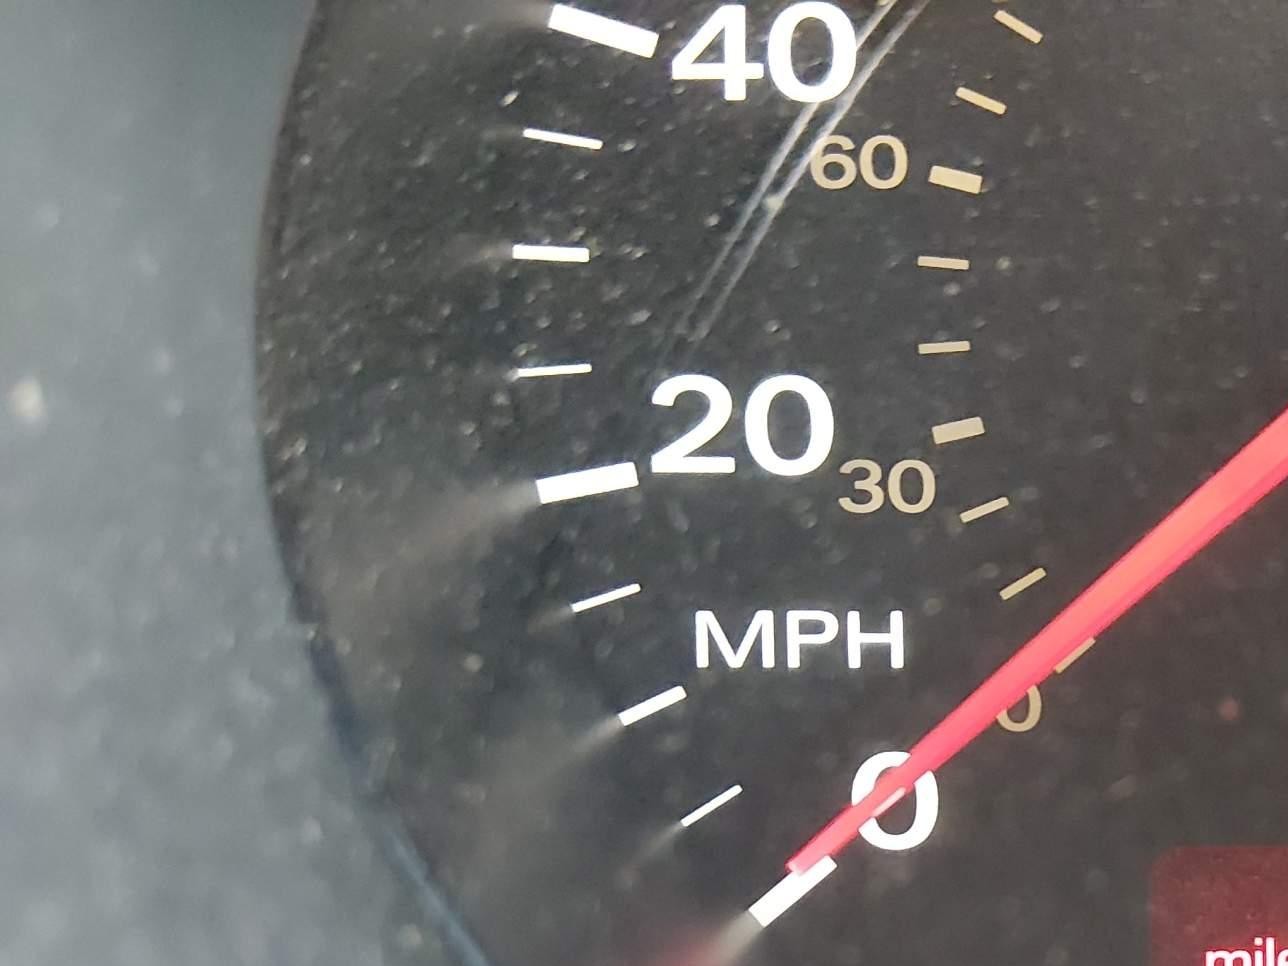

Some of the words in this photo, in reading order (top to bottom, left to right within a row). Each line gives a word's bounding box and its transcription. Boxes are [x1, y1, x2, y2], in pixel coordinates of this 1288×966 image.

[671, 1, 858, 102] 40
[810, 135, 908, 190] 60
[651, 374, 834, 476] 20
[838, 459, 936, 514] 30
[695, 609, 905, 669] MPH
[851, 751, 939, 850] 0
